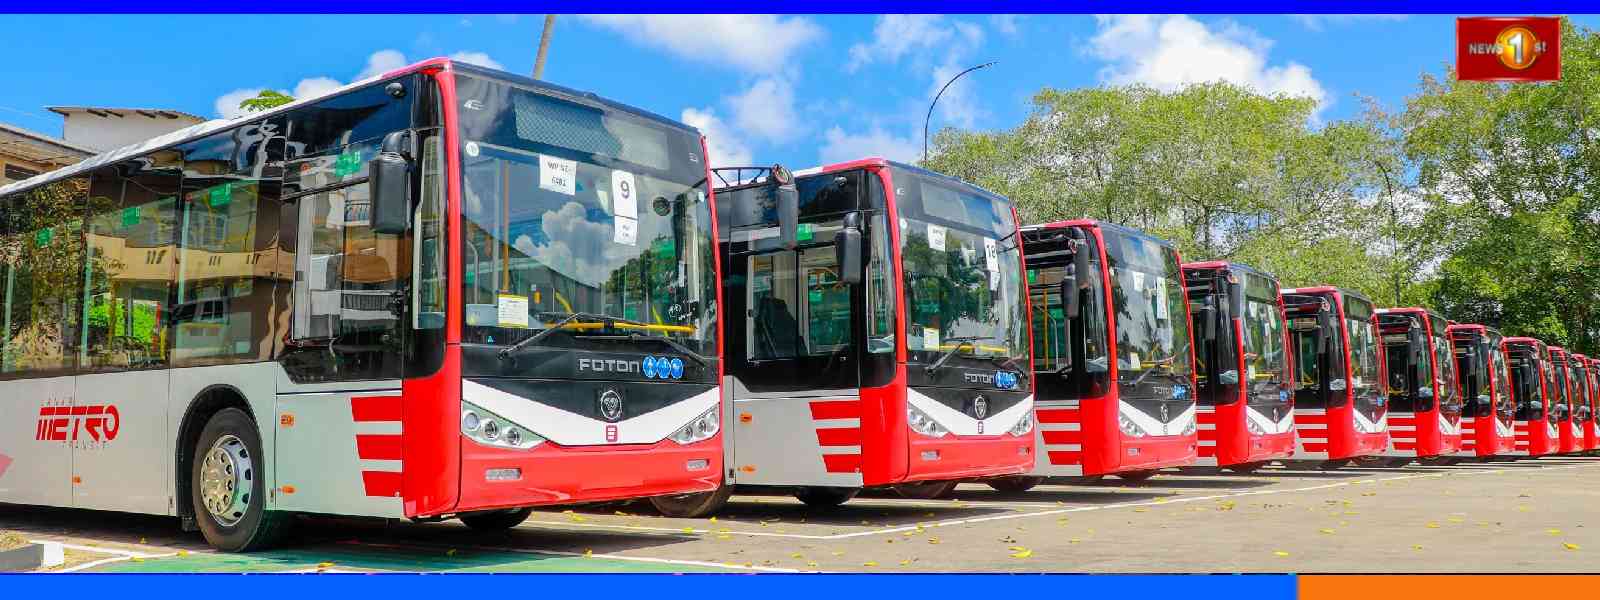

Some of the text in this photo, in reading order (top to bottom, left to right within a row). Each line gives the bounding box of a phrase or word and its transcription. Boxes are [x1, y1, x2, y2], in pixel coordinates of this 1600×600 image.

[620, 180, 630, 199] 9
[579, 358, 640, 373] FOTON
[36, 405, 120, 441] METRO
